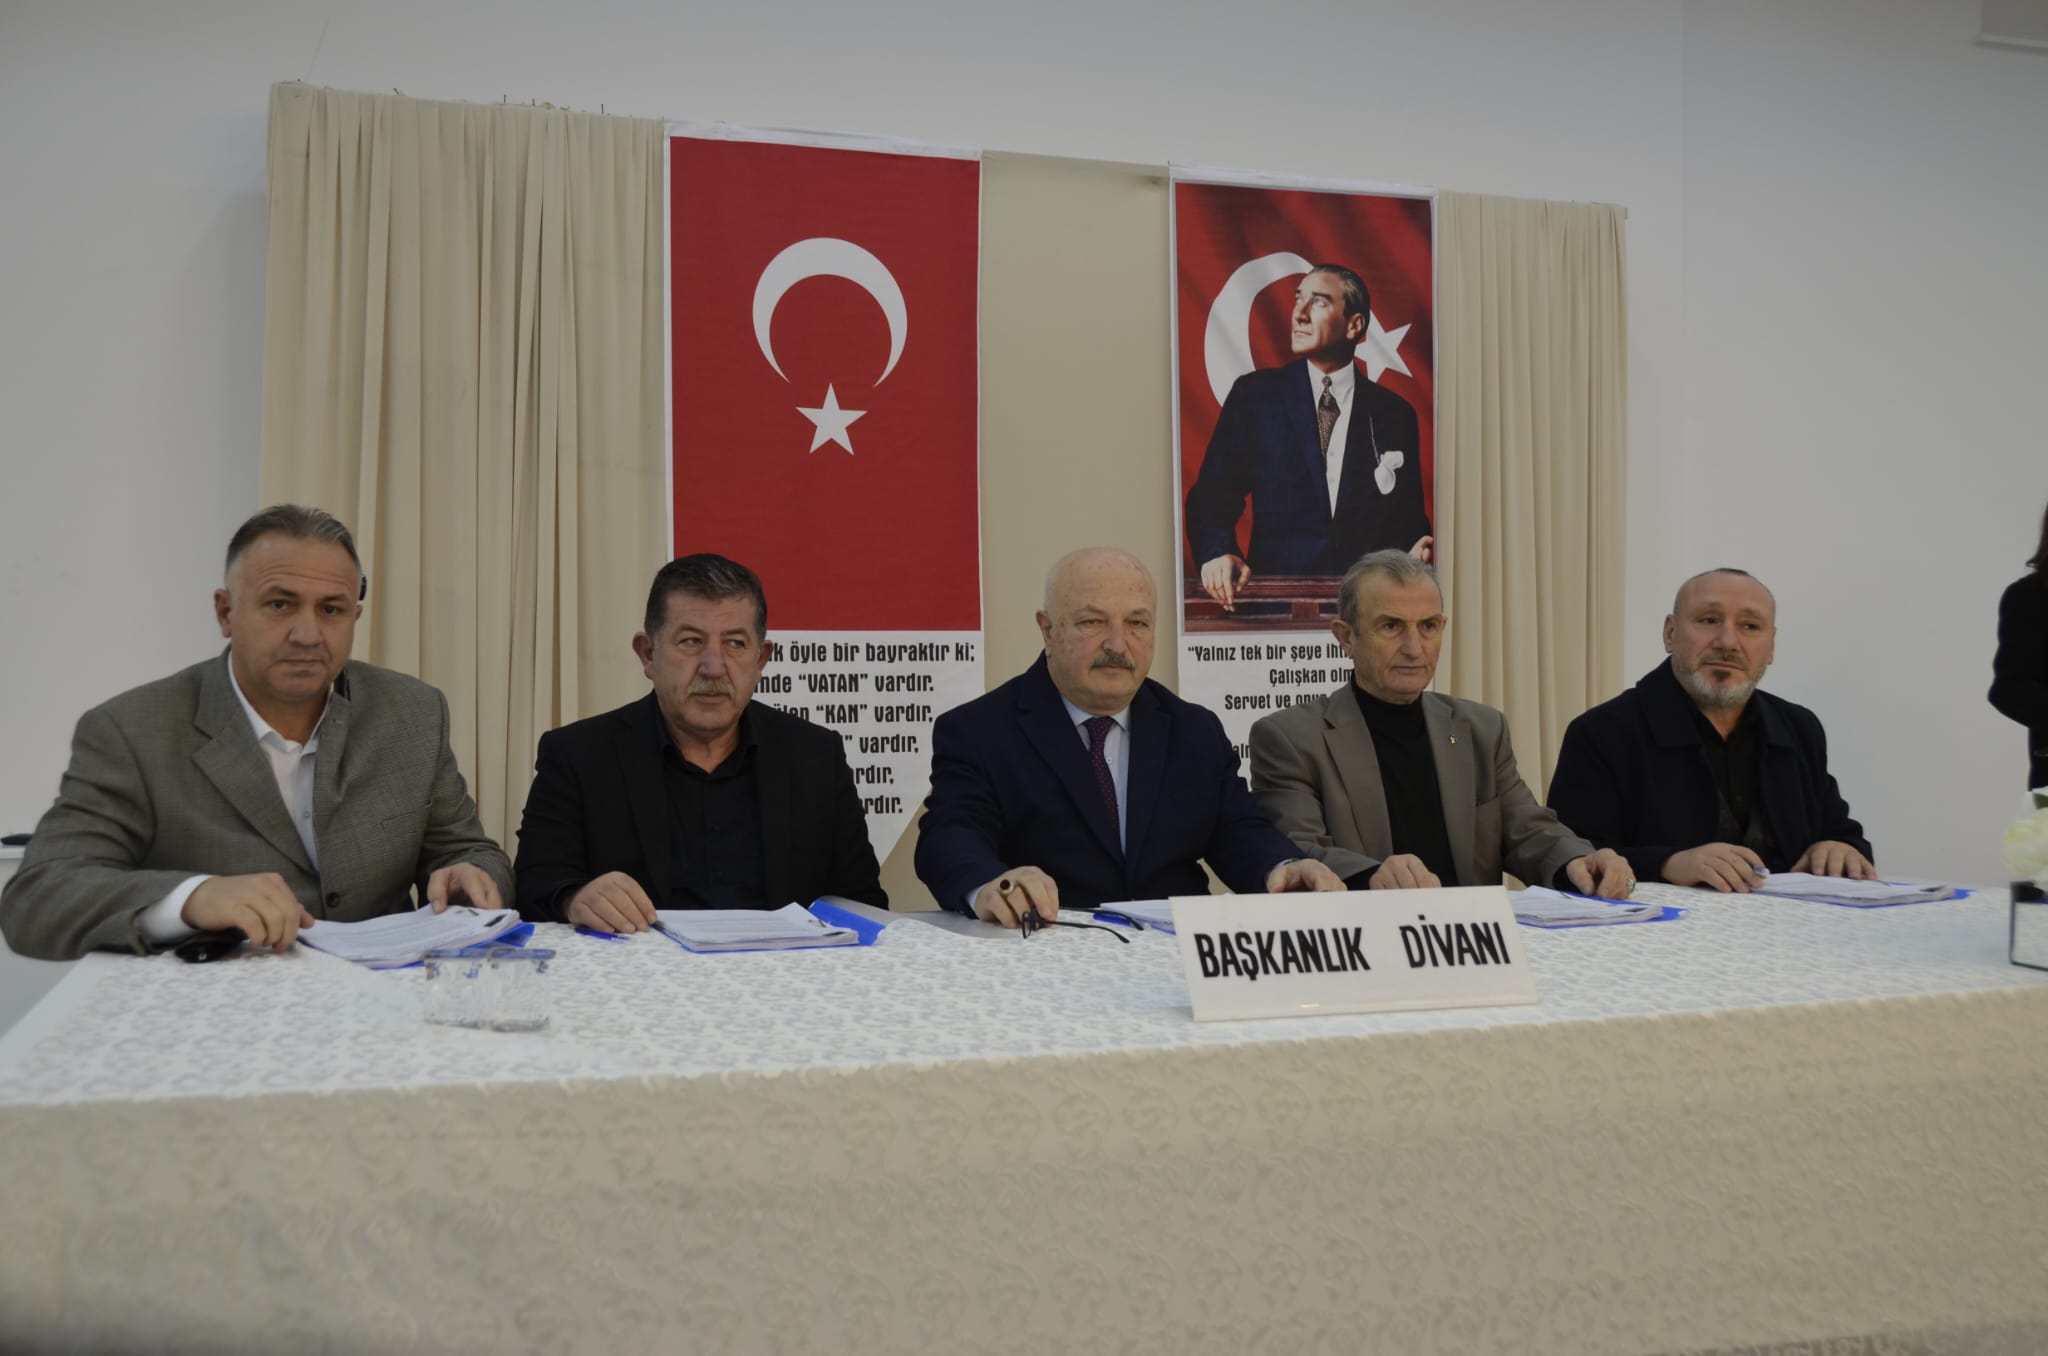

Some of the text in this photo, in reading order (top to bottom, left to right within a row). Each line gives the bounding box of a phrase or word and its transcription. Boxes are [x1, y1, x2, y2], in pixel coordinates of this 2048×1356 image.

[790, 641, 827, 664] öyle
[833, 642, 860, 662] bir
[866, 642, 950, 664] bayraktır
[955, 642, 975, 662] ki;
[1188, 645, 1236, 662] “Yalnız
[1240, 645, 1262, 661] tek
[1266, 644, 1287, 660] bir
[1290, 645, 1322, 662] şeye
[799, 673, 868, 693] “VATAN”
[875, 673, 934, 692] vardır.
[1269, 668, 1326, 687] Çalışkan
[1224, 694, 1271, 710] Servet
[1275, 694, 1291, 709] ve
[816, 704, 867, 724] “KAN”
[852, 764, 894, 785] rdır,
[863, 795, 903, 815] rdır.
[1194, 914, 1511, 981] BAŞKANLIK DİVANI
